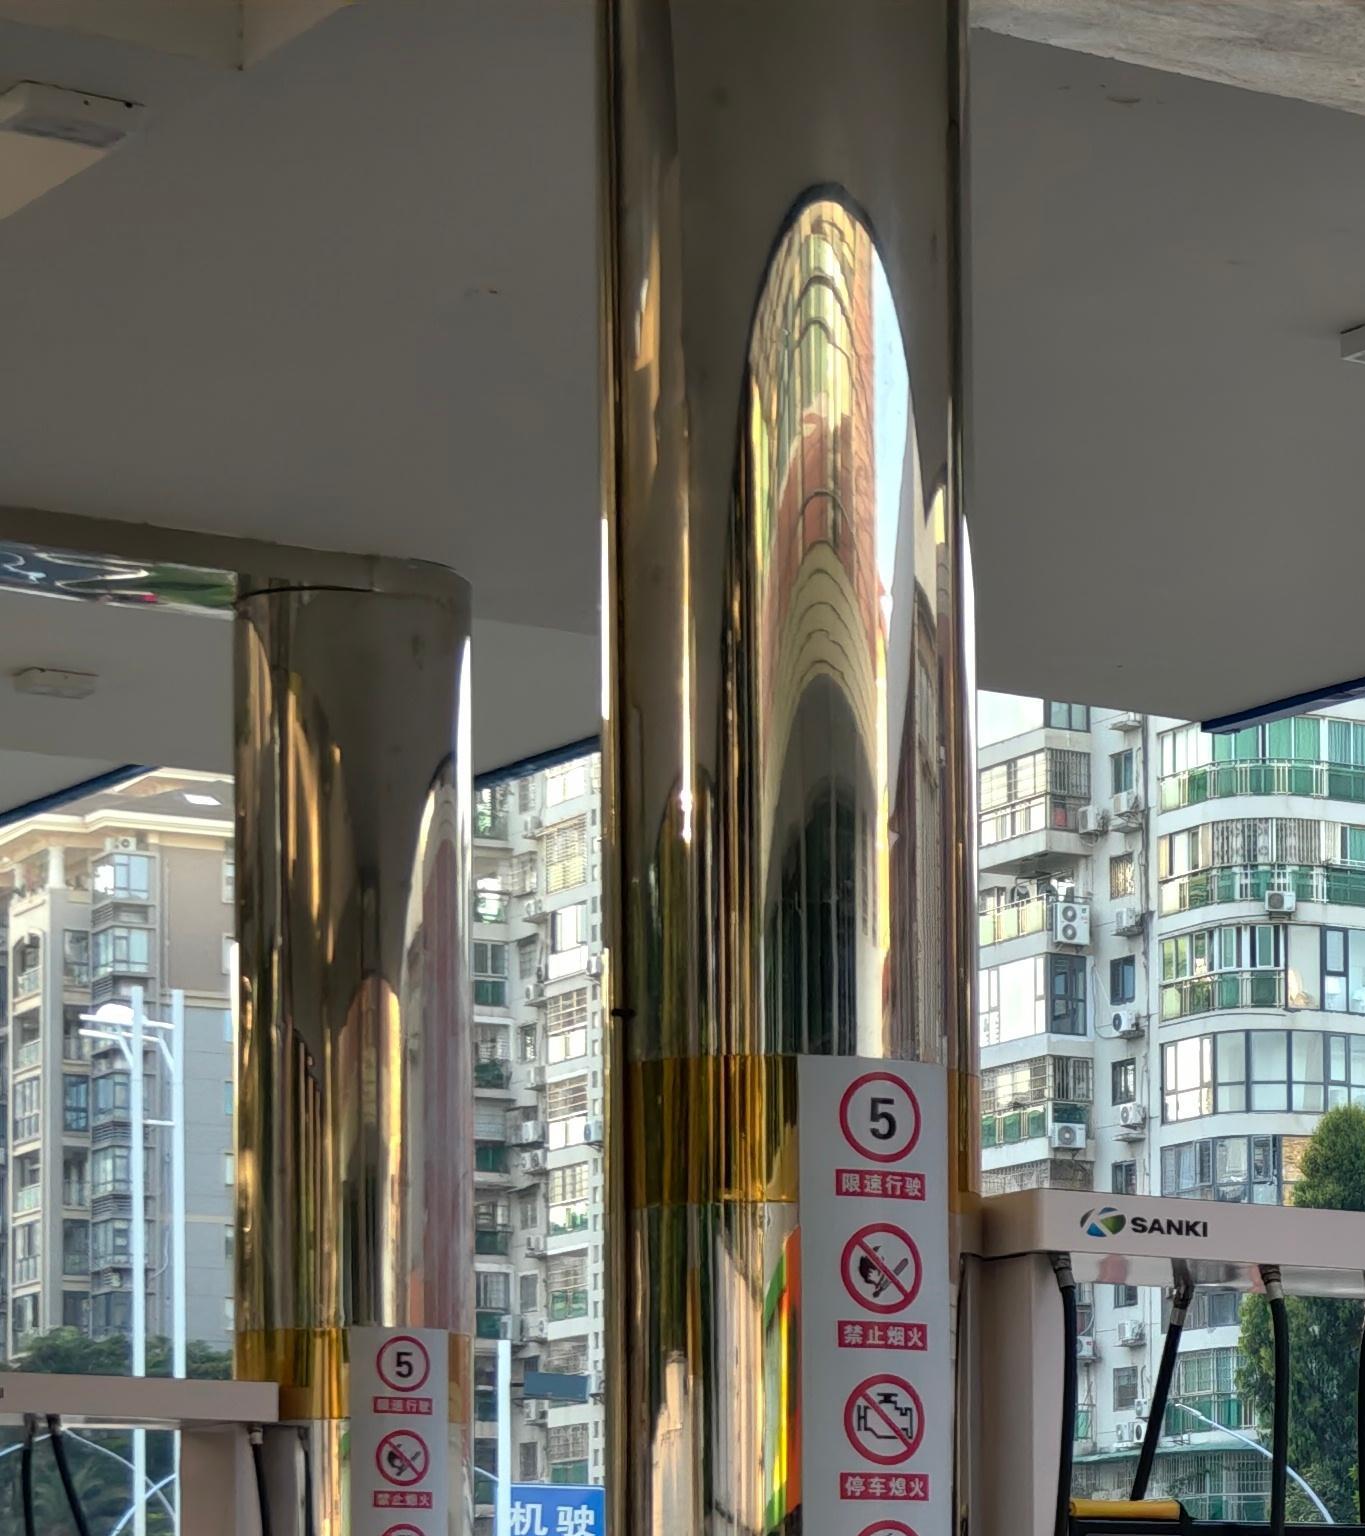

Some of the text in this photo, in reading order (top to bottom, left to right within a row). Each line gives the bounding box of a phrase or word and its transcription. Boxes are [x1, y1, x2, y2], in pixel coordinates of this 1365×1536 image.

[869, 1097, 896, 1139] 5
[842, 1173, 922, 1199] 限速行驶
[1131, 1217, 1208, 1237] SANKI
[843, 1324, 924, 1349] 禁止烟火
[395, 1352, 413, 1379] 5
[845, 1476, 925, 1500] 停车熄火
